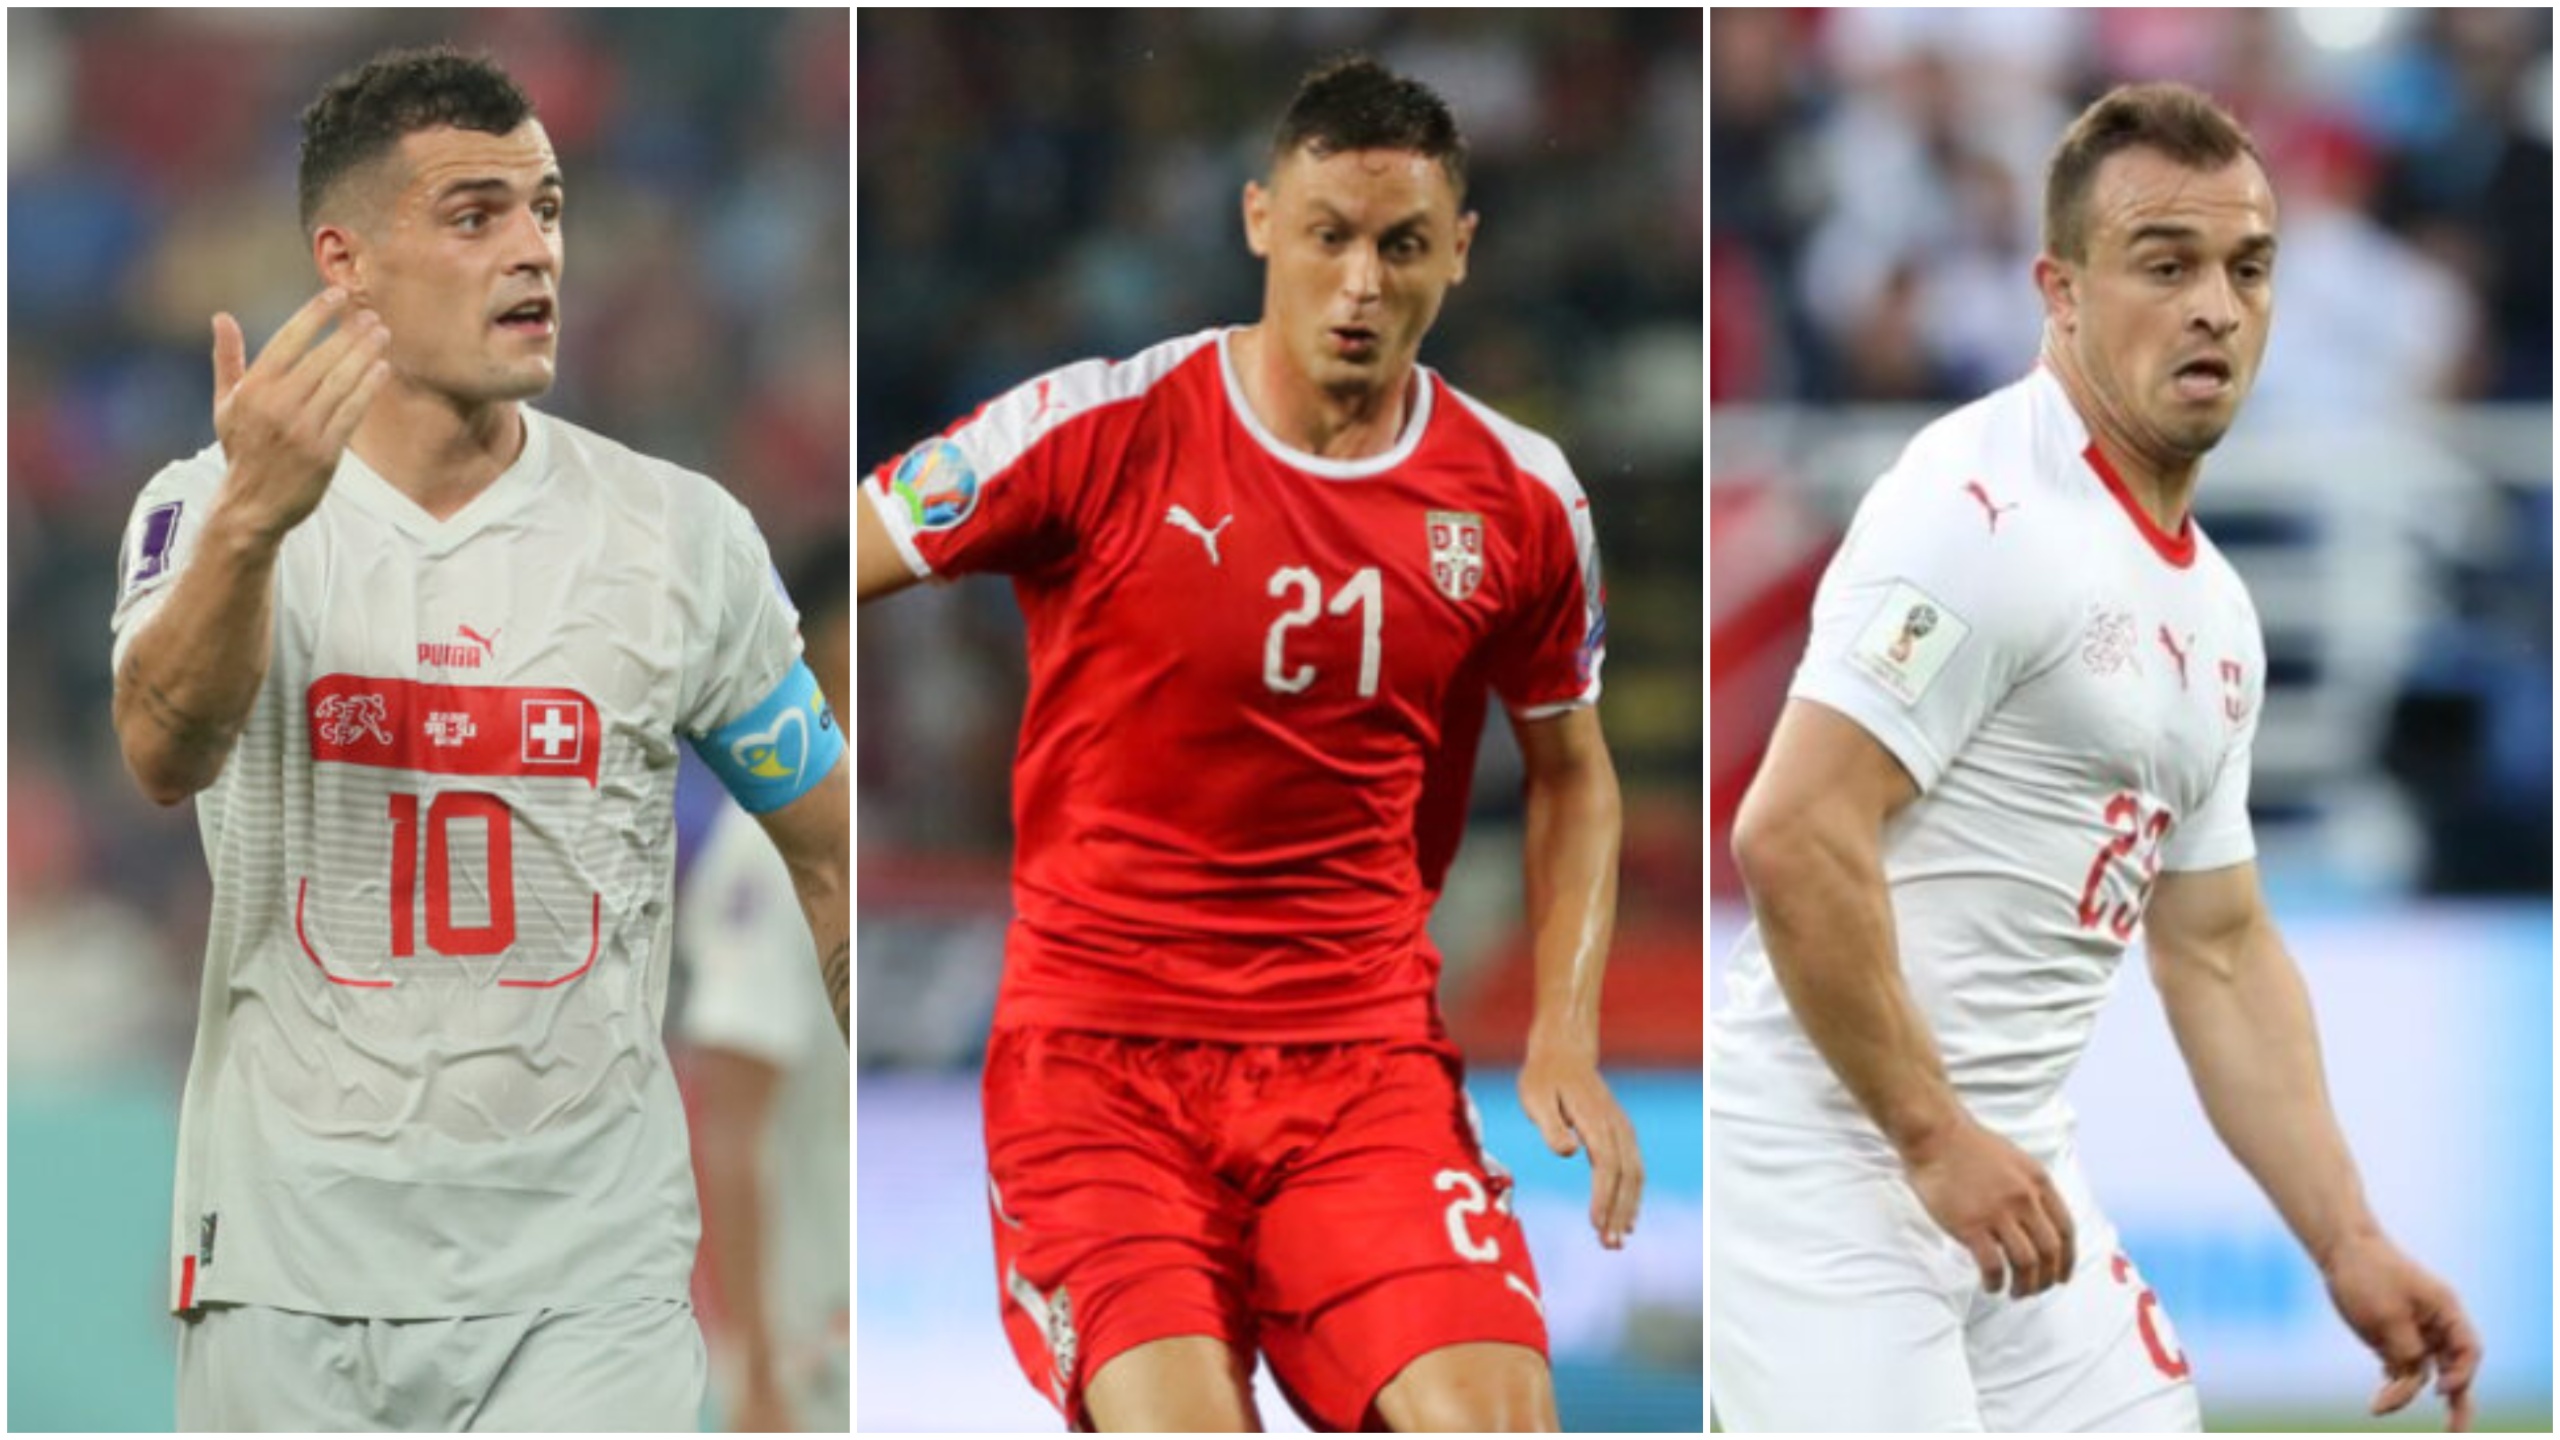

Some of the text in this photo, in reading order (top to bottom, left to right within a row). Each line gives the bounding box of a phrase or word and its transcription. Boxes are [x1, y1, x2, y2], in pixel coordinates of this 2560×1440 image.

[417, 643, 481, 668] PUMA
[1263, 566, 1383, 697] 21
[387, 791, 516, 957] 10
